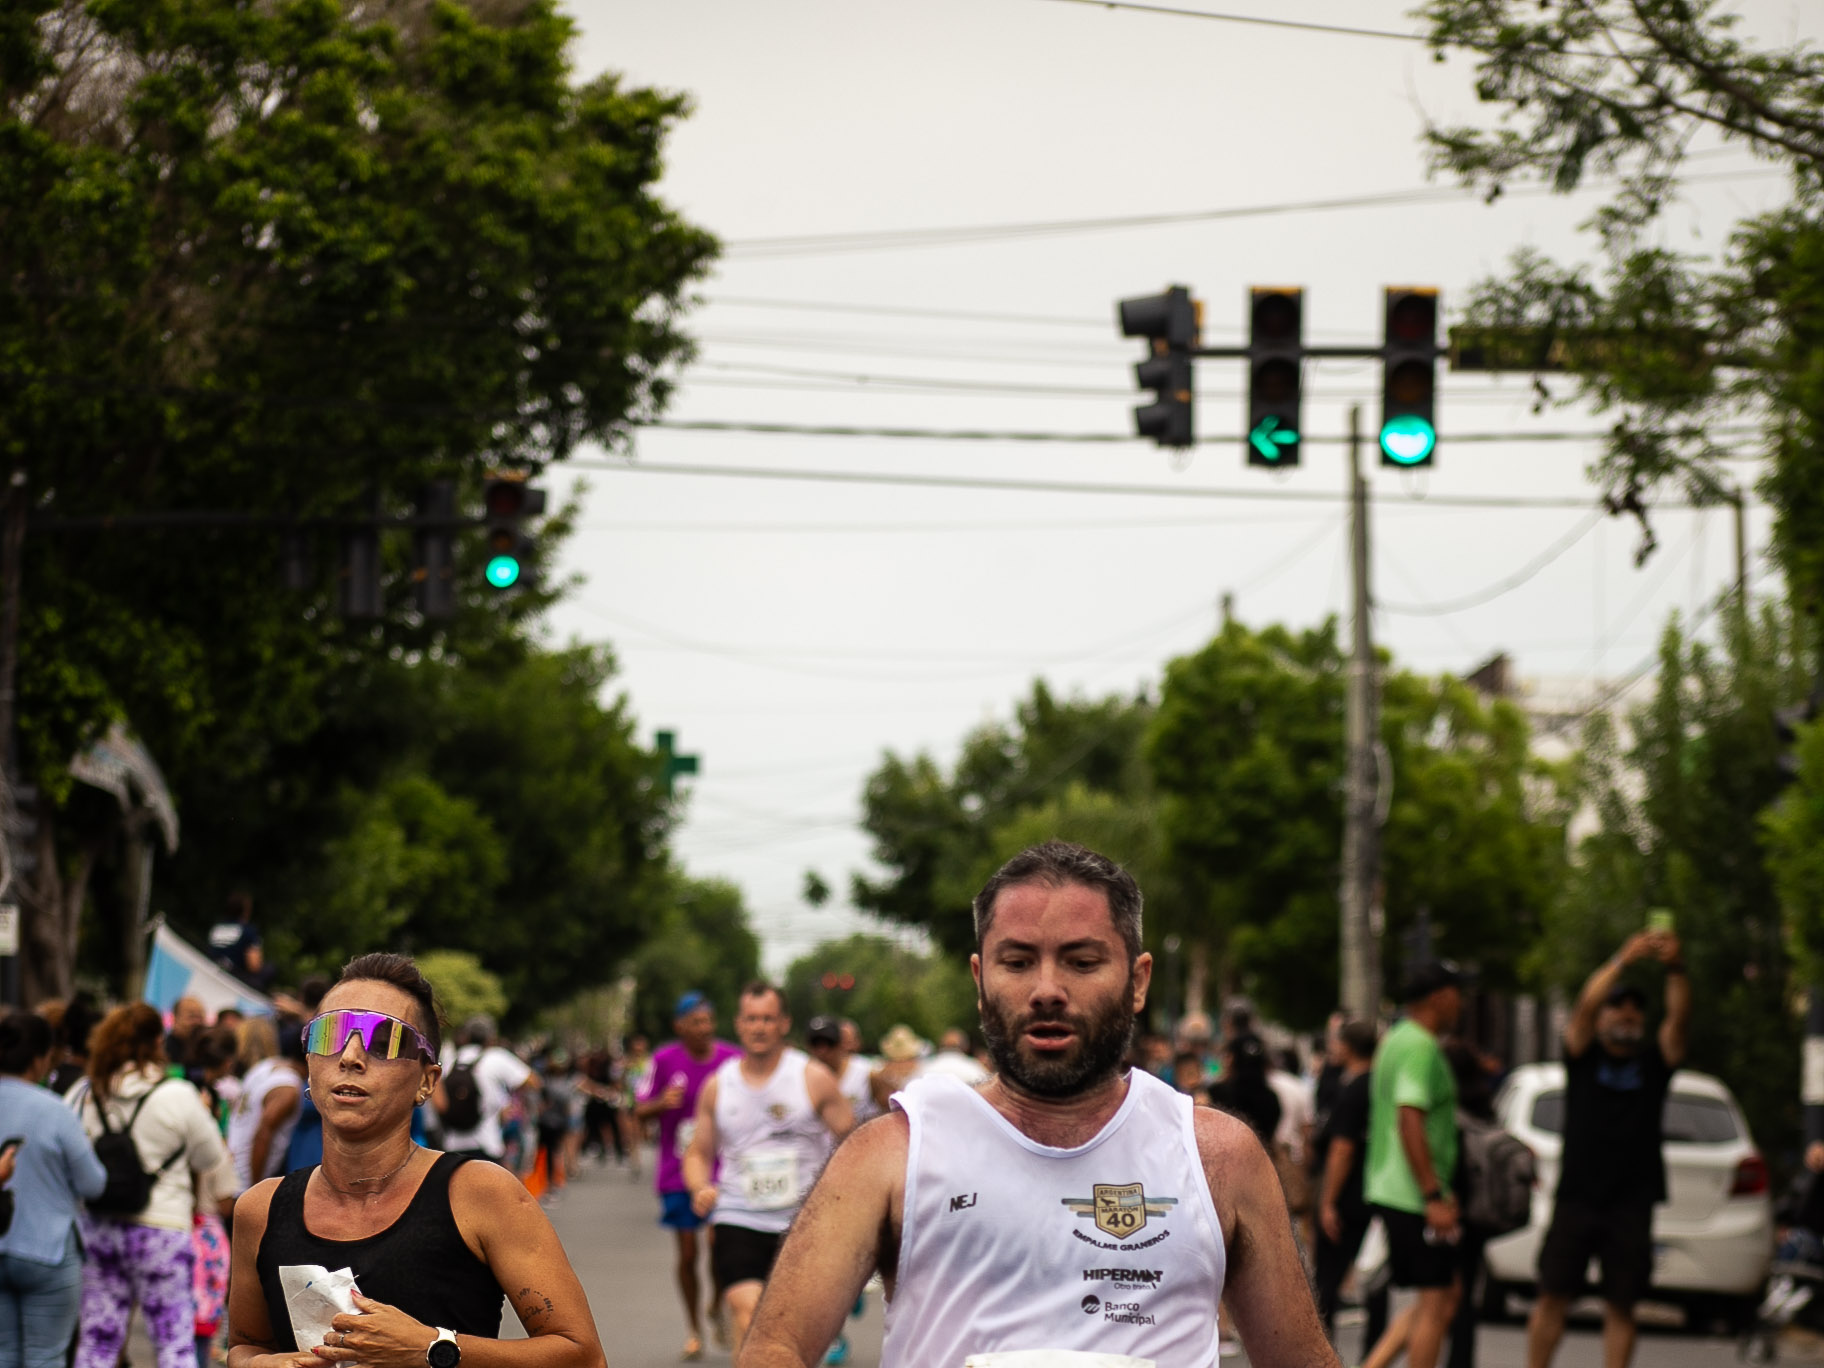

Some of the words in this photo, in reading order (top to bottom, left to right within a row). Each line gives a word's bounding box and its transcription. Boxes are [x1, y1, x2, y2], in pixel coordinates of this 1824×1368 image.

[1099, 1188, 1138, 1196] ARGENTINA
[949, 1193, 977, 1213] NEJ
[1106, 1212, 1135, 1228] 40
[1072, 1228, 1118, 1251] EMPALME
[1120, 1229, 1171, 1252] GRANEROS
[1104, 1301, 1140, 1312] Banco
[1104, 1312, 1156, 1327] Municipal
